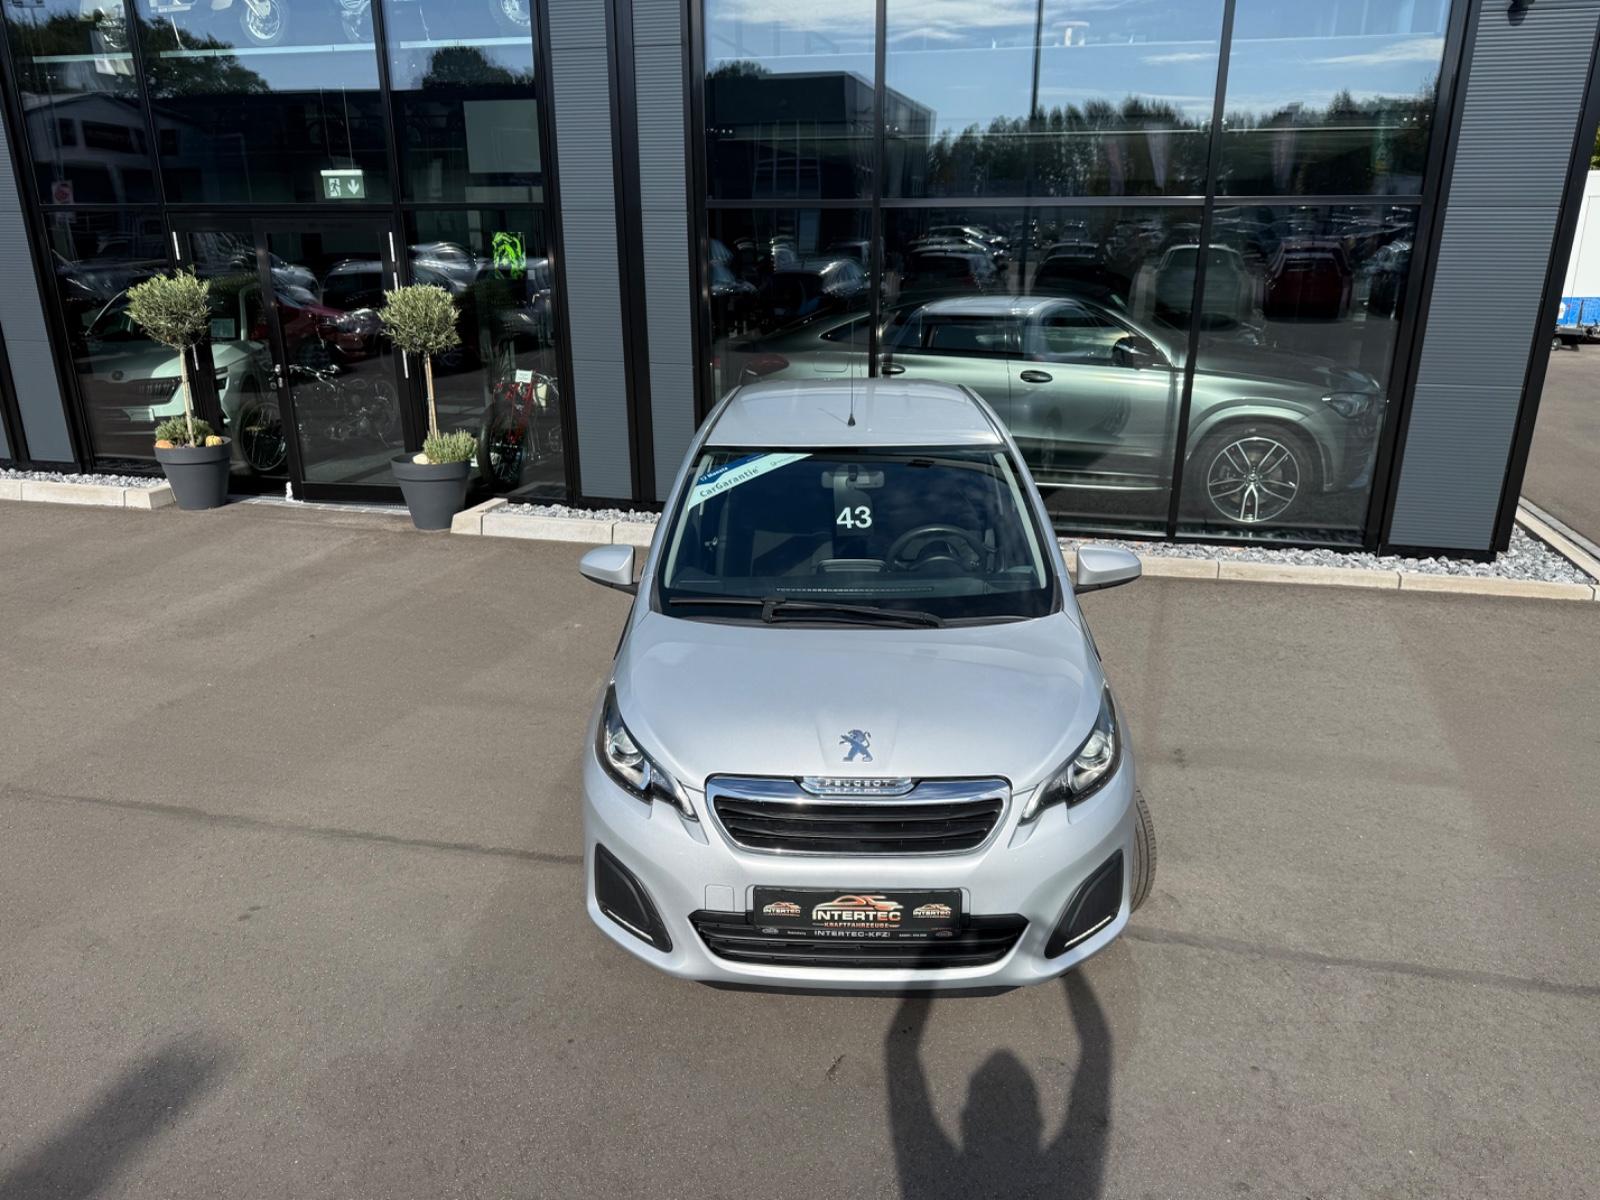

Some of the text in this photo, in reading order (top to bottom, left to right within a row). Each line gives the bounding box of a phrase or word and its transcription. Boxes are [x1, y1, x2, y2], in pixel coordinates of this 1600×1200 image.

[699, 467, 759, 498] CarGarantie
[836, 505, 873, 529] 43
[825, 779, 891, 788] PEUGEOT
[811, 910, 902, 921] INTERTEC
